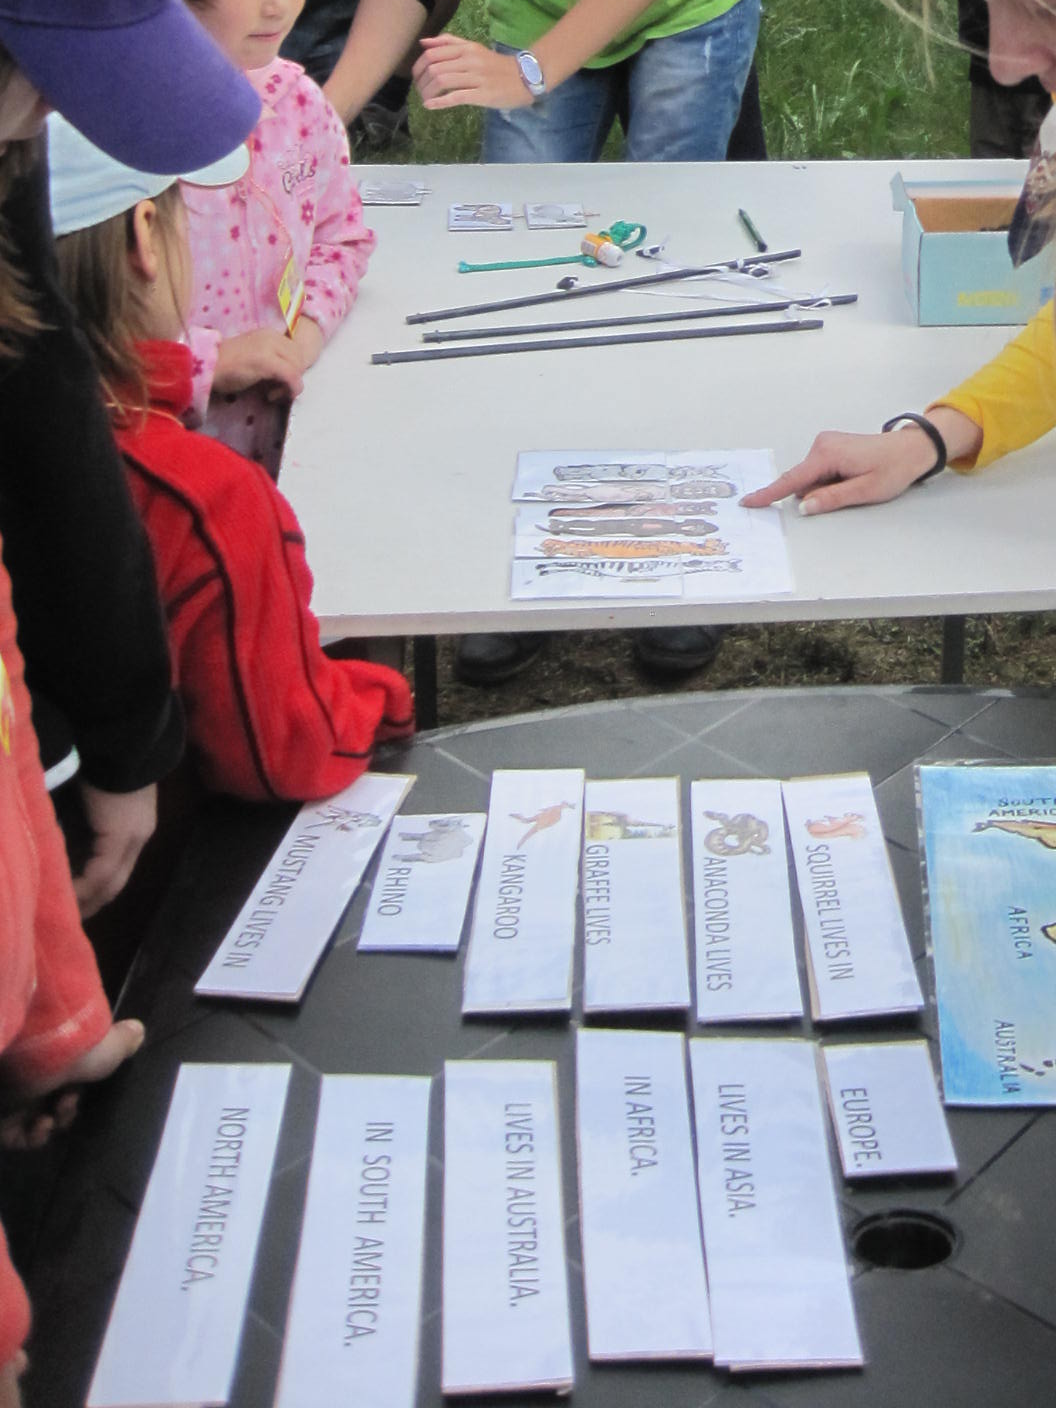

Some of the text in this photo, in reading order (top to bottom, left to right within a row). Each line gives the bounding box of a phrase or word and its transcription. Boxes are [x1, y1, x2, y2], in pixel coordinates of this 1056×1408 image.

[222, 835, 320, 968] MUSTANG LIVES IN
[377, 867, 412, 917] RHINO
[493, 854, 527, 940] KANGAROO
[585, 844, 611, 946] GIRAFFE LIVES
[704, 857, 732, 992] ANACONDA LIVES
[806, 844, 855, 981] SQUIRREL LIVES IN
[1007, 906, 1034, 960] AFRICA
[995, 1019, 1022, 1093] AUSTRALIA
[624, 1076, 658, 1176] IN AFRICA.
[718, 1084, 756, 1218] LIVES IN ASIA.
[840, 1088, 882, 1167] EUROPE.
[181, 1107, 250, 1291] NORTH AMERICA.
[344, 1122, 394, 1347] IN SOUTH AMERICA.
[505, 1103, 541, 1307] LIVES IN AUSTRALIA.
